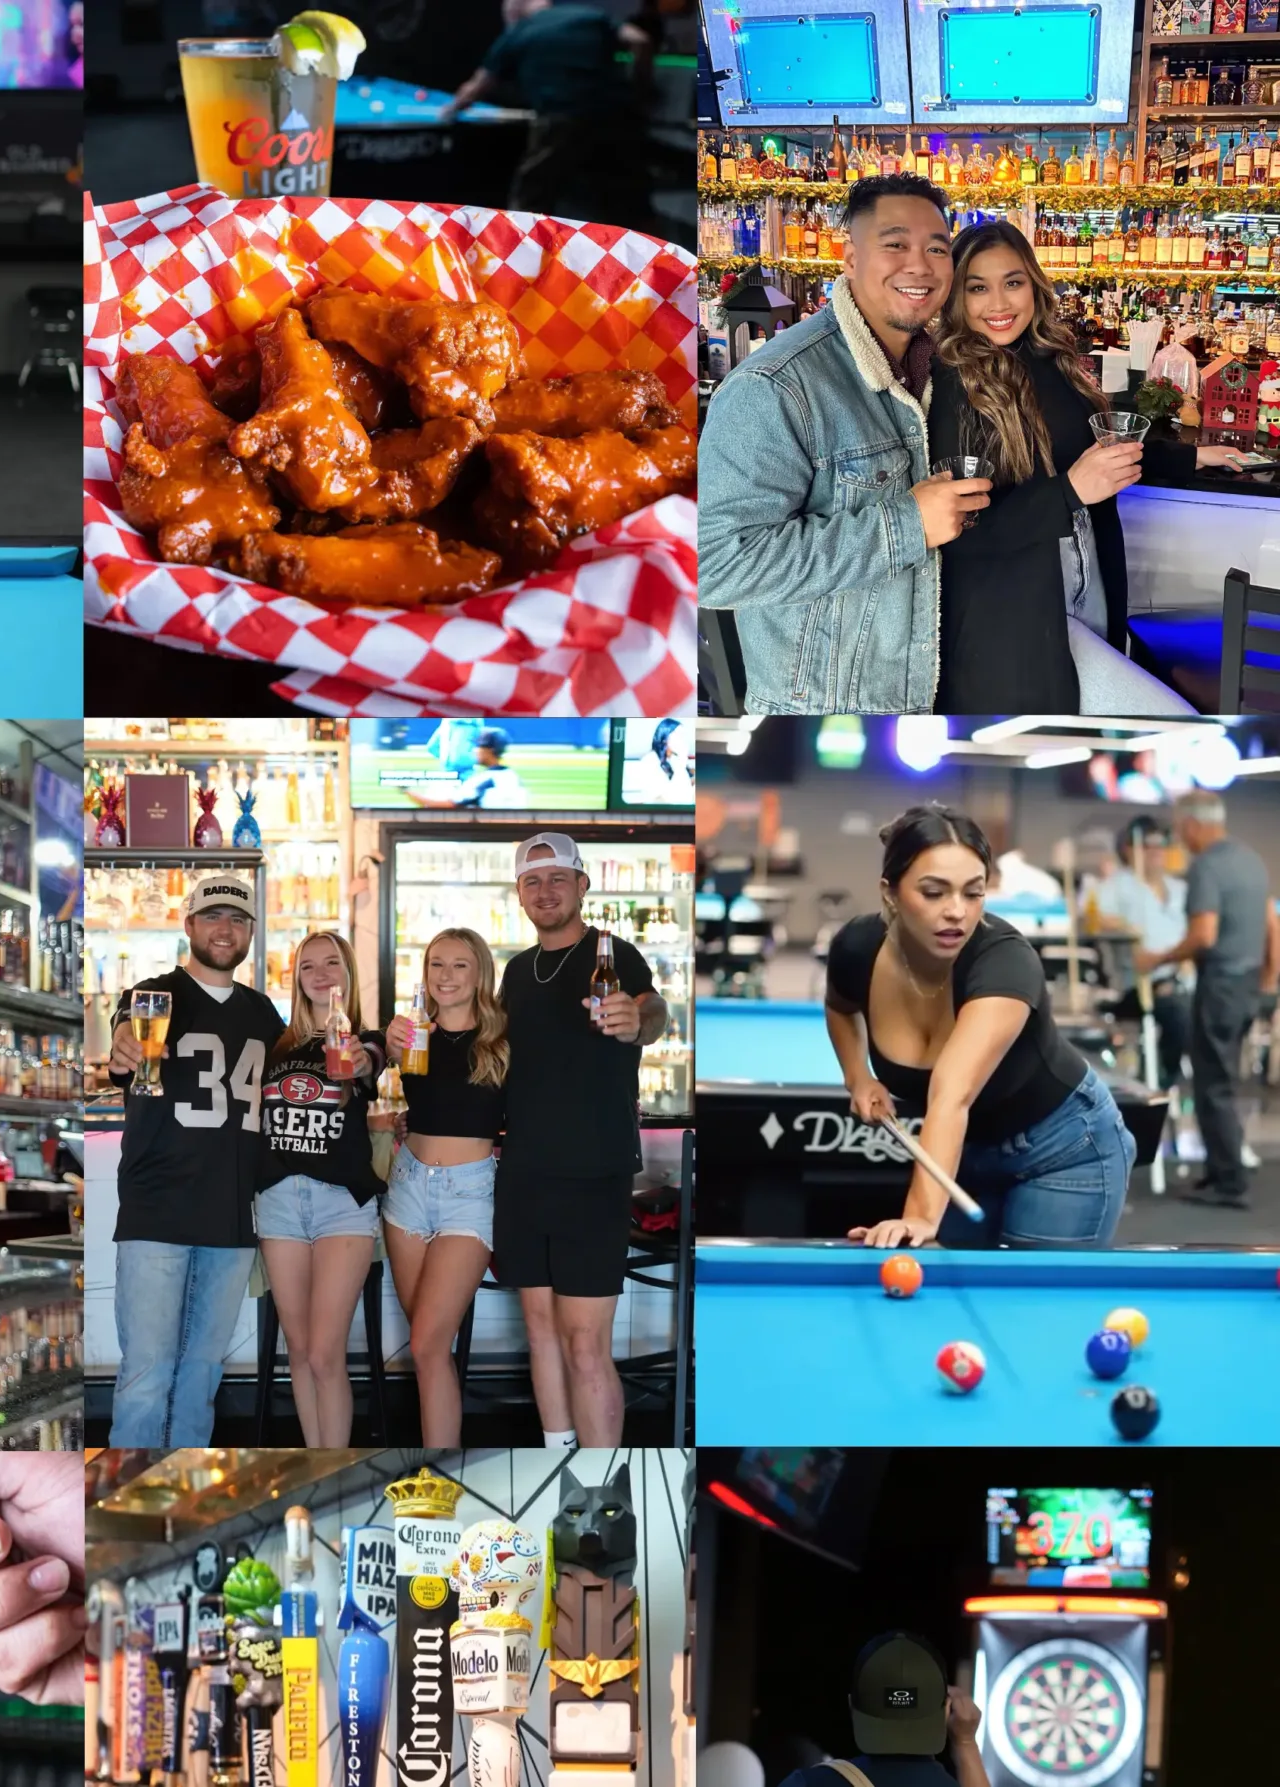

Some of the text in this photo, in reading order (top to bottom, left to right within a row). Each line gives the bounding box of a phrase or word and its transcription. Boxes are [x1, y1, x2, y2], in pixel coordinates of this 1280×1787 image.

[243, 161, 329, 195] LIGHT
[203, 885, 248, 900] RAIDERS
[174, 1032, 266, 1133] 34
[268, 1062, 289, 1079] SAN
[262, 1107, 345, 1140] 49ERS
[398, 1524, 461, 1546] Corona
[1027, 1511, 1112, 1557] 370
[358, 1541, 396, 1566] MIN
[416, 1542, 446, 1556] Extra
[357, 1564, 396, 1589] HAZ
[423, 1565, 438, 1575] 1925
[367, 1595, 397, 1617] IPA
[158, 1620, 179, 1643] IPA
[237, 1639, 275, 1659] Space
[452, 1649, 499, 1676] Modelo
[127, 1650, 142, 1737] STONE
[459, 1690, 491, 1708] Especial
[286, 1667, 312, 1761] PACIFICO
[397, 1627, 451, 1787] Corona
[347, 1654, 362, 1787] FIRESTON
